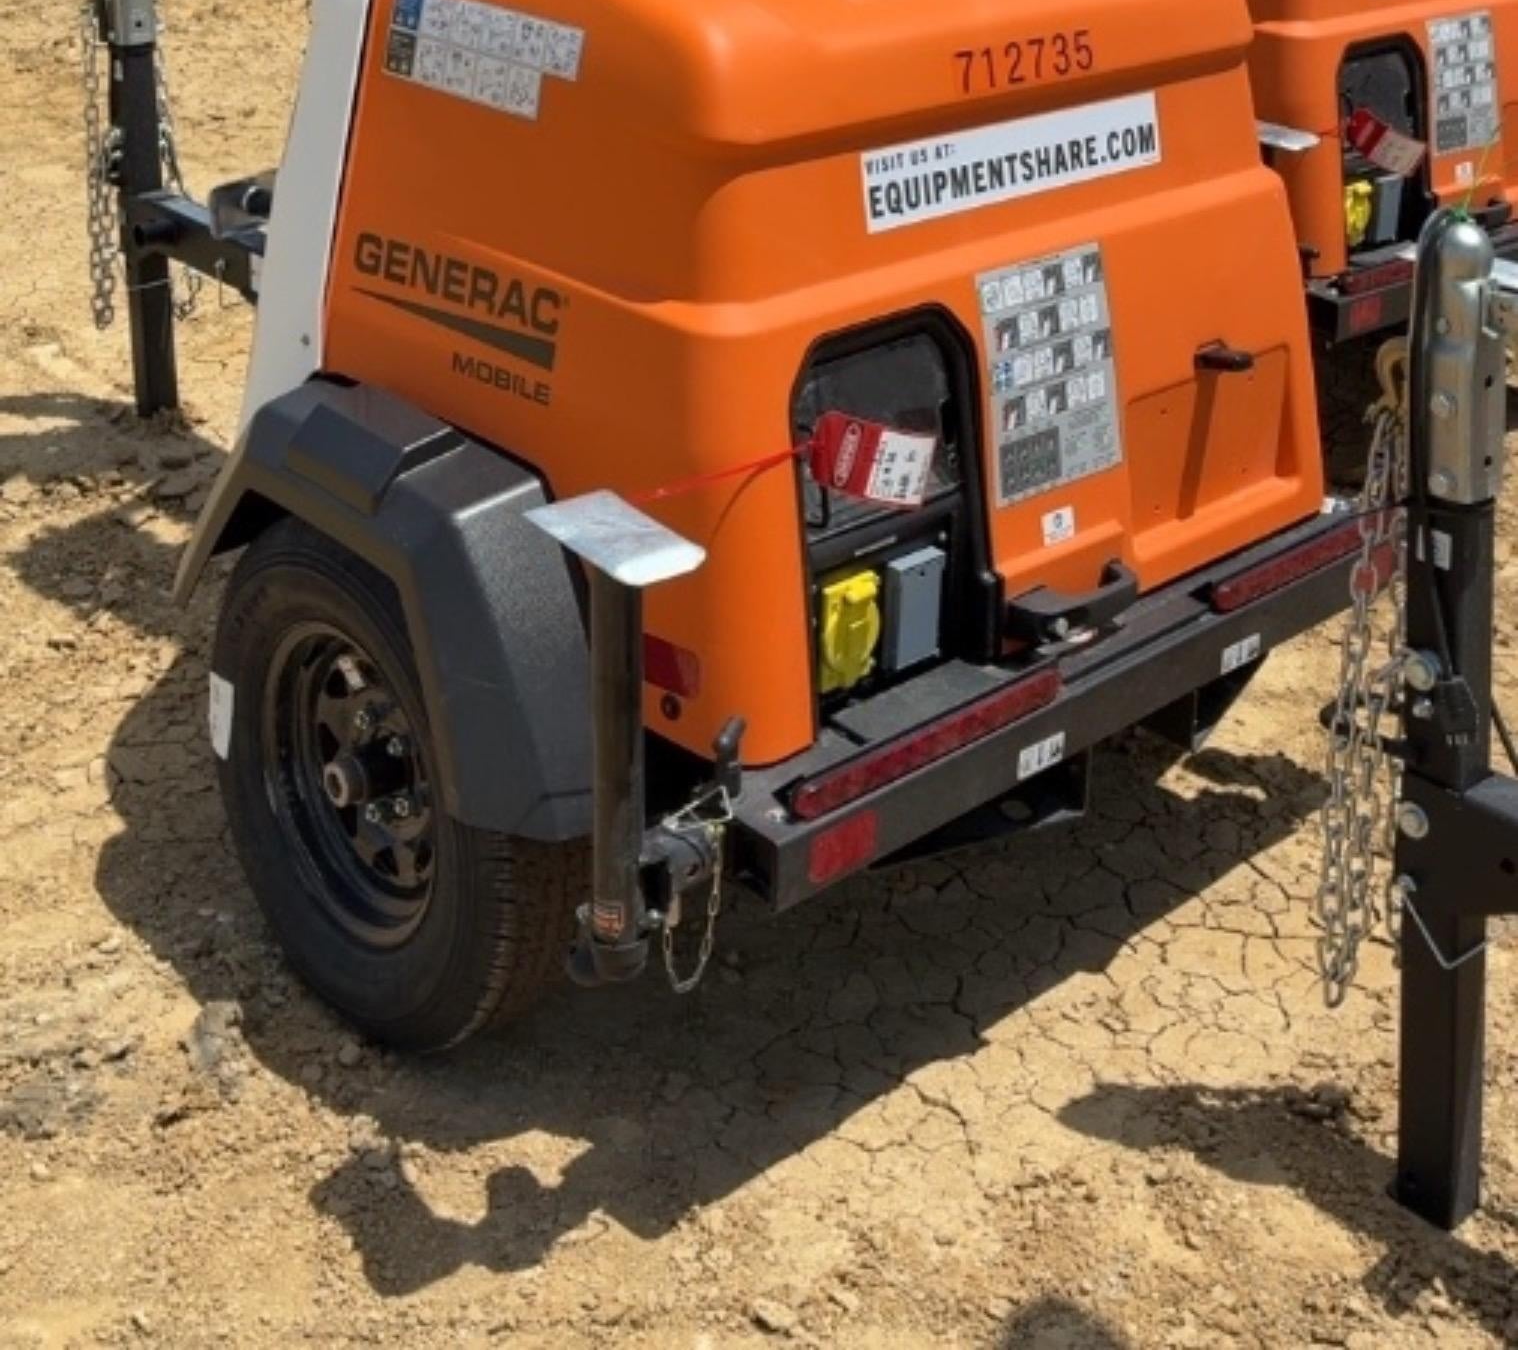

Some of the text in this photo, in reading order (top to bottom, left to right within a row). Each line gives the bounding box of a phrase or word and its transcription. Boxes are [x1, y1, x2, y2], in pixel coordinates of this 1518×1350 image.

[954, 29, 1094, 94] 712735
[865, 152, 904, 175] VISIT
[910, 147, 928, 166] US
[869, 122, 1156, 220] EQUIPMENTSHARE.COM
[353, 232, 559, 336] GENERAC
[452, 352, 551, 407] MOBILE
